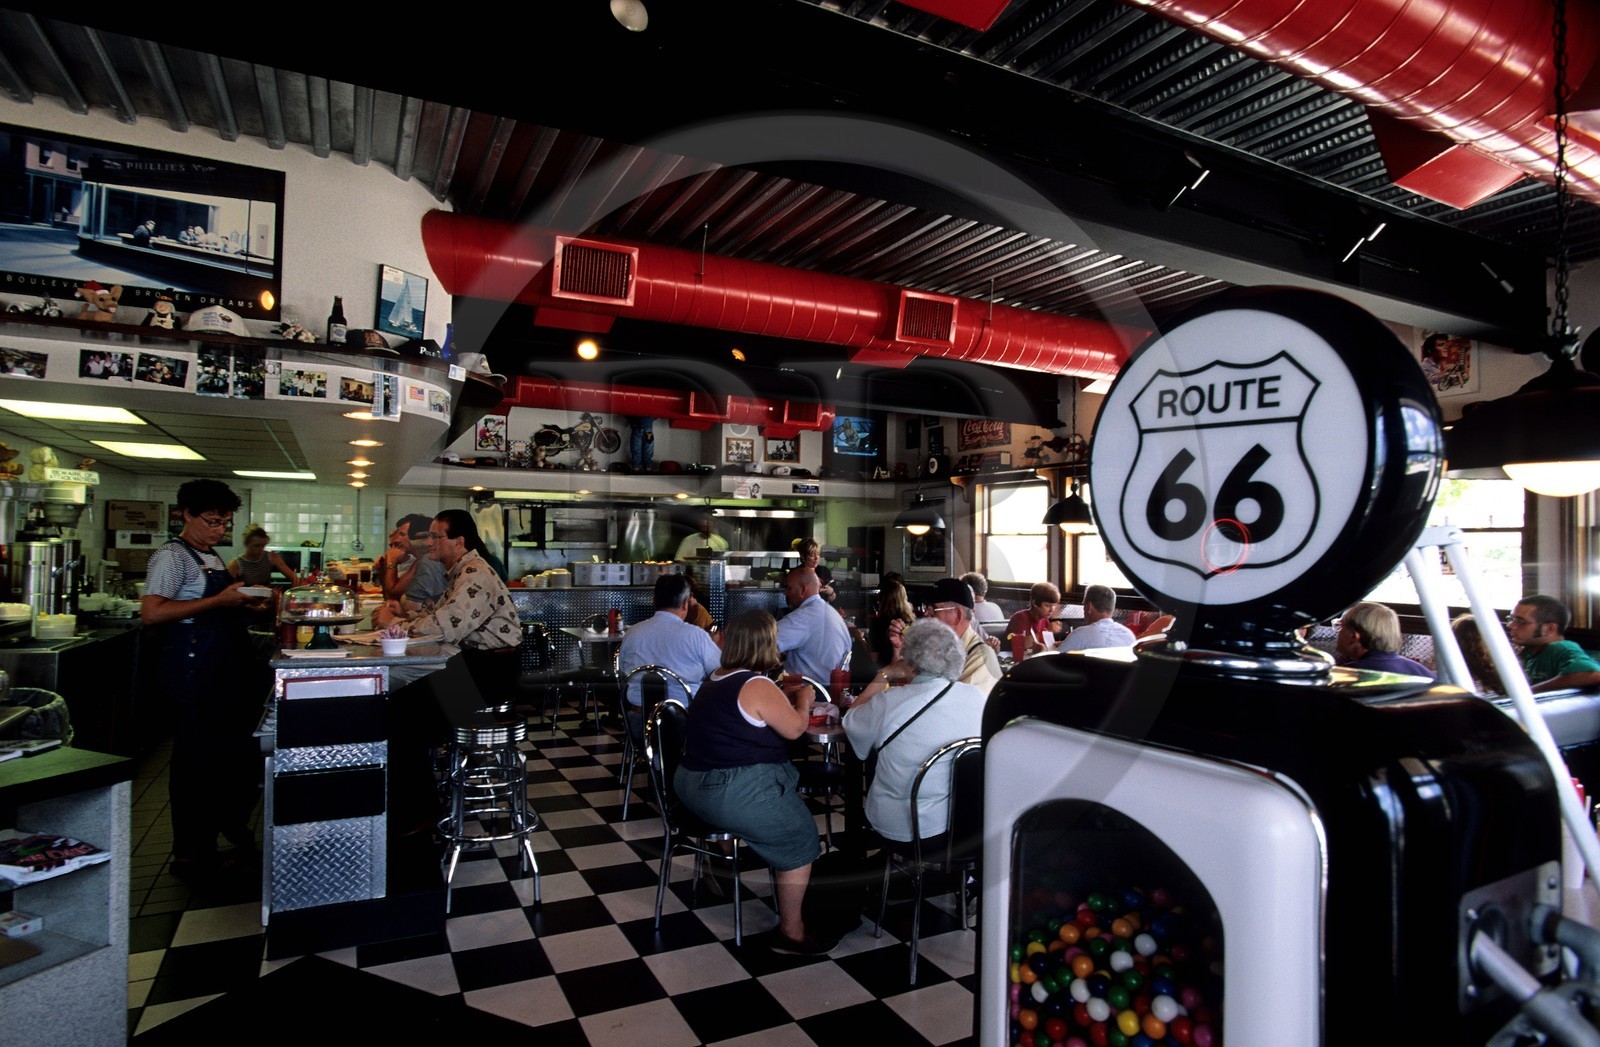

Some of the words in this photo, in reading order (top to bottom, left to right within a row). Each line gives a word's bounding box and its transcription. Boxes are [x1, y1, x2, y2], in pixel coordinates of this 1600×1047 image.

[125, 161, 186, 172] PHILLIES
[6, 274, 80, 288] BOULEVA
[135, 289, 191, 301] BROEN
[199, 296, 254, 309] DREAMS
[1156, 375, 1282, 419] ROUTE
[1146, 443, 1285, 544] 66
